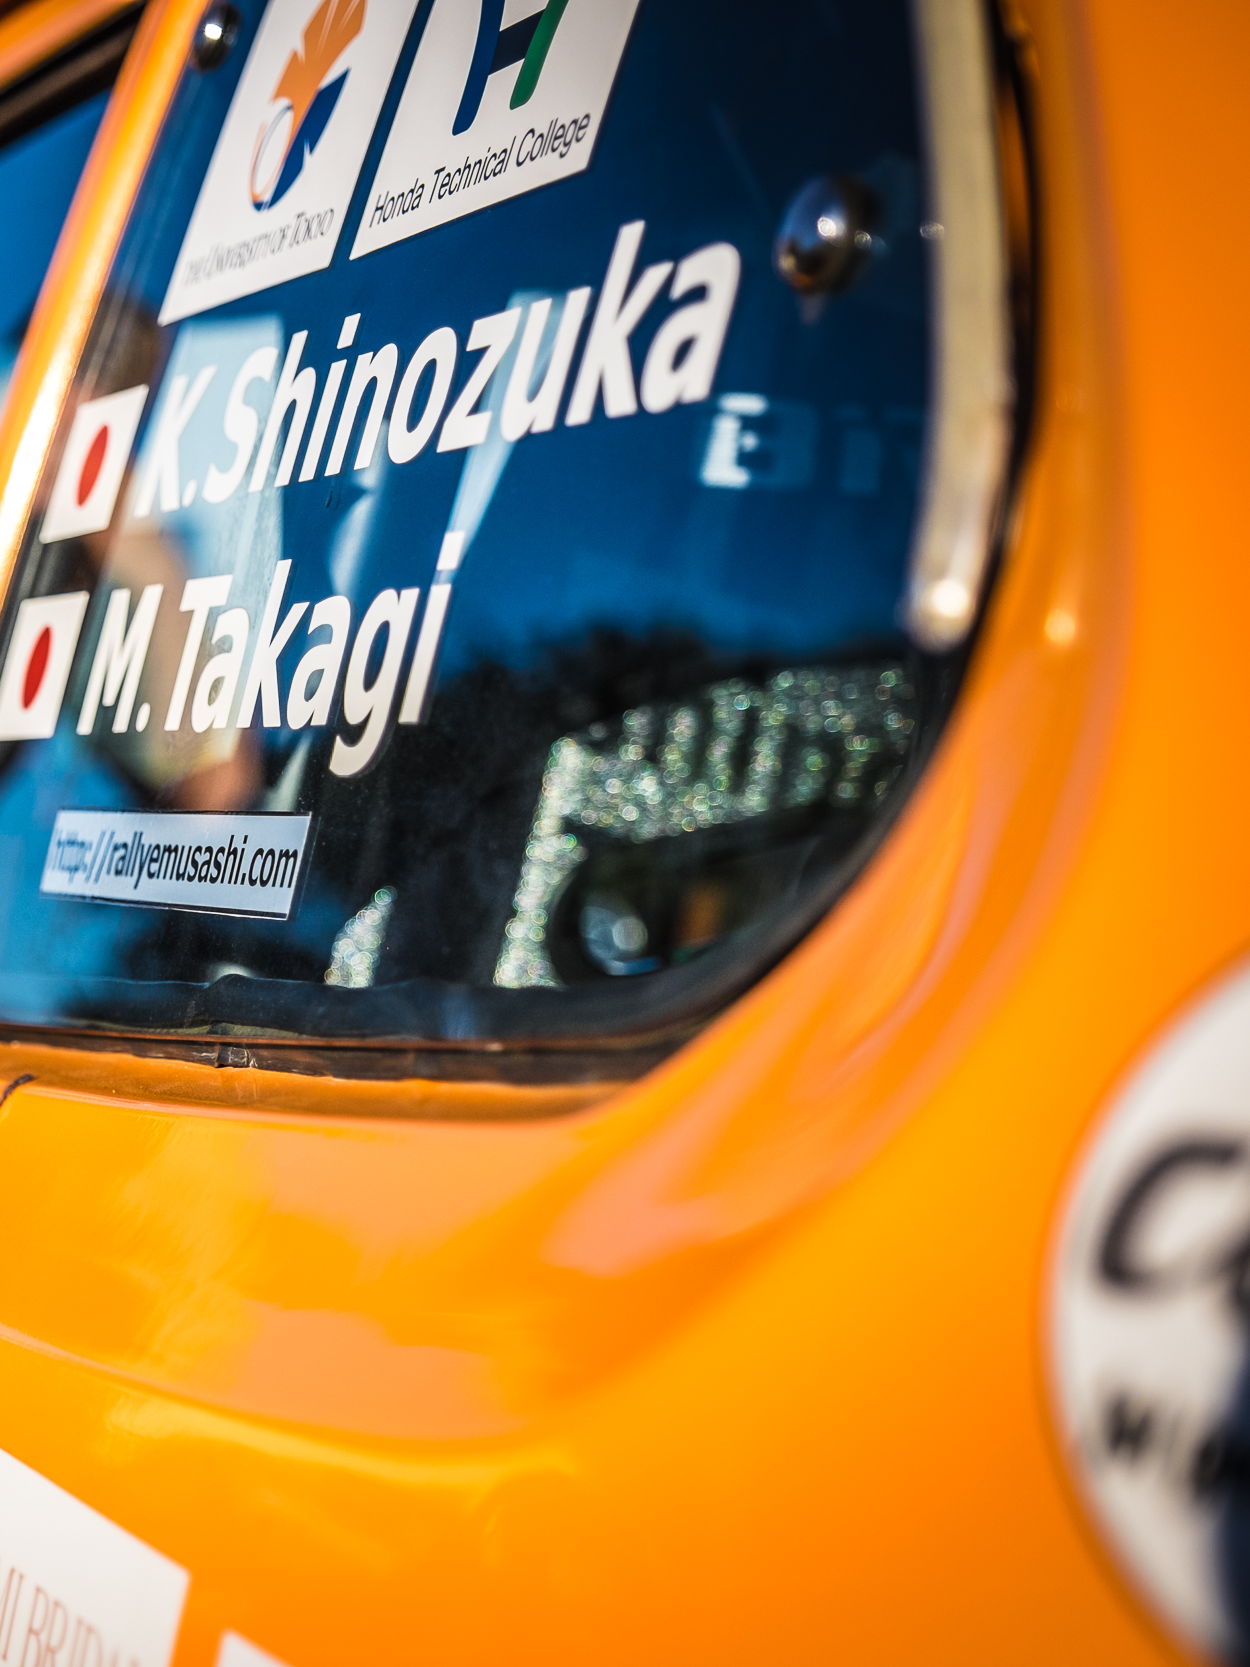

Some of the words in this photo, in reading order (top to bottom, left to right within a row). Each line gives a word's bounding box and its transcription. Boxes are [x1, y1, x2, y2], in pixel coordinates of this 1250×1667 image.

[369, 178, 425, 228] Honda
[429, 136, 516, 204] Technical
[516, 113, 591, 167] College
[289, 207, 335, 249] TOKYO
[51, 827, 299, 890] http://rallyemusashi.com
